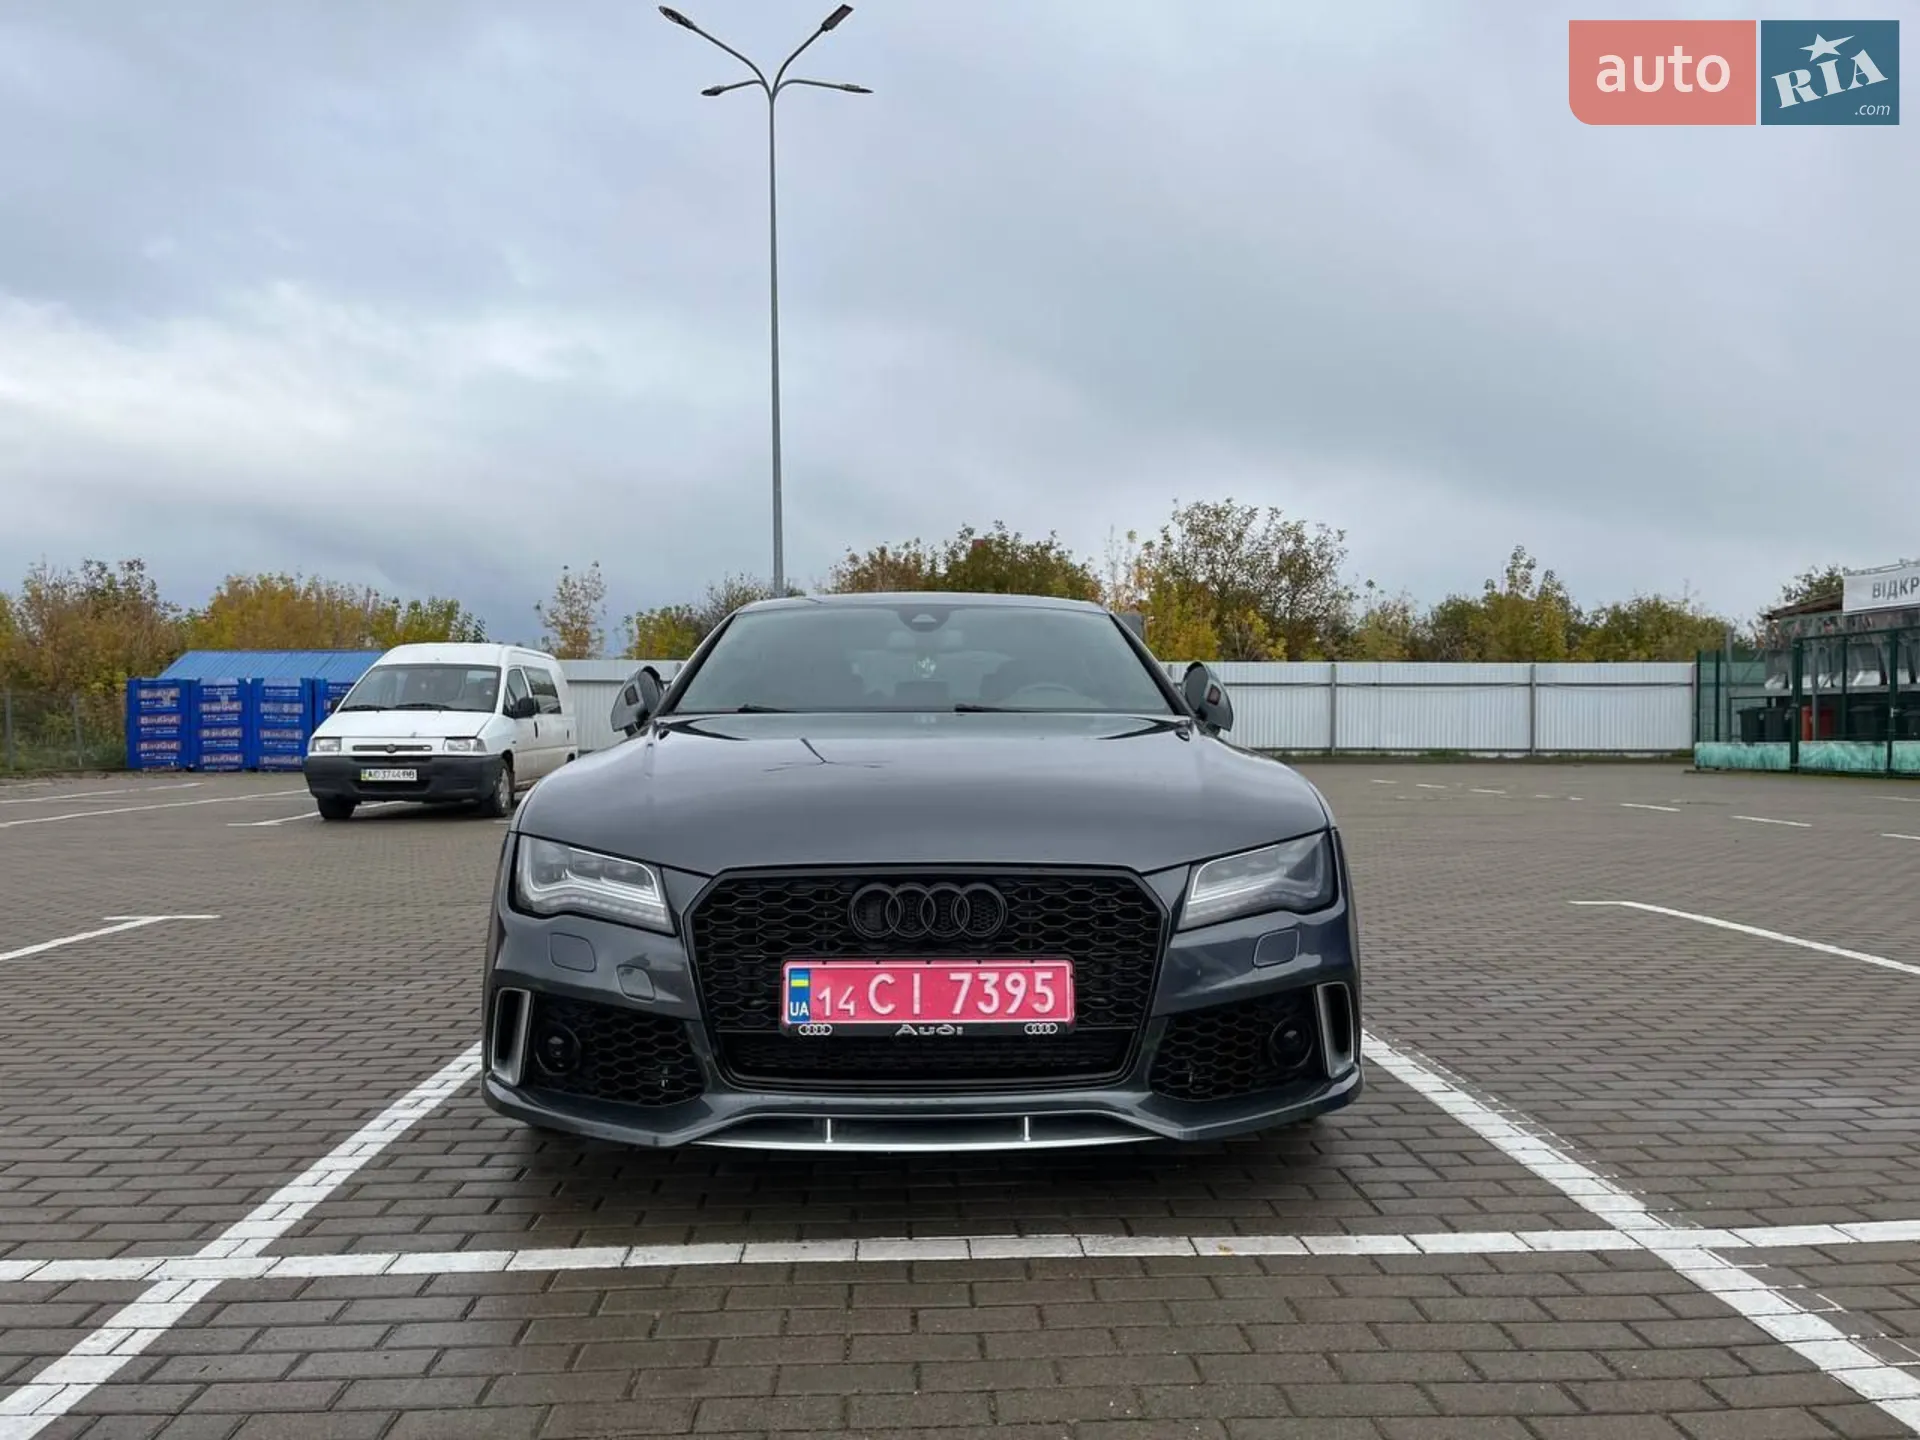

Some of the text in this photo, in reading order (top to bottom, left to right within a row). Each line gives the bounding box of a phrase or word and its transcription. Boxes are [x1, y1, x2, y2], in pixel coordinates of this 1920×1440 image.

[817, 972, 1055, 1016] 14 CI 7395
[789, 1001, 810, 1017] UA
[895, 1023, 964, 1036] Audi
